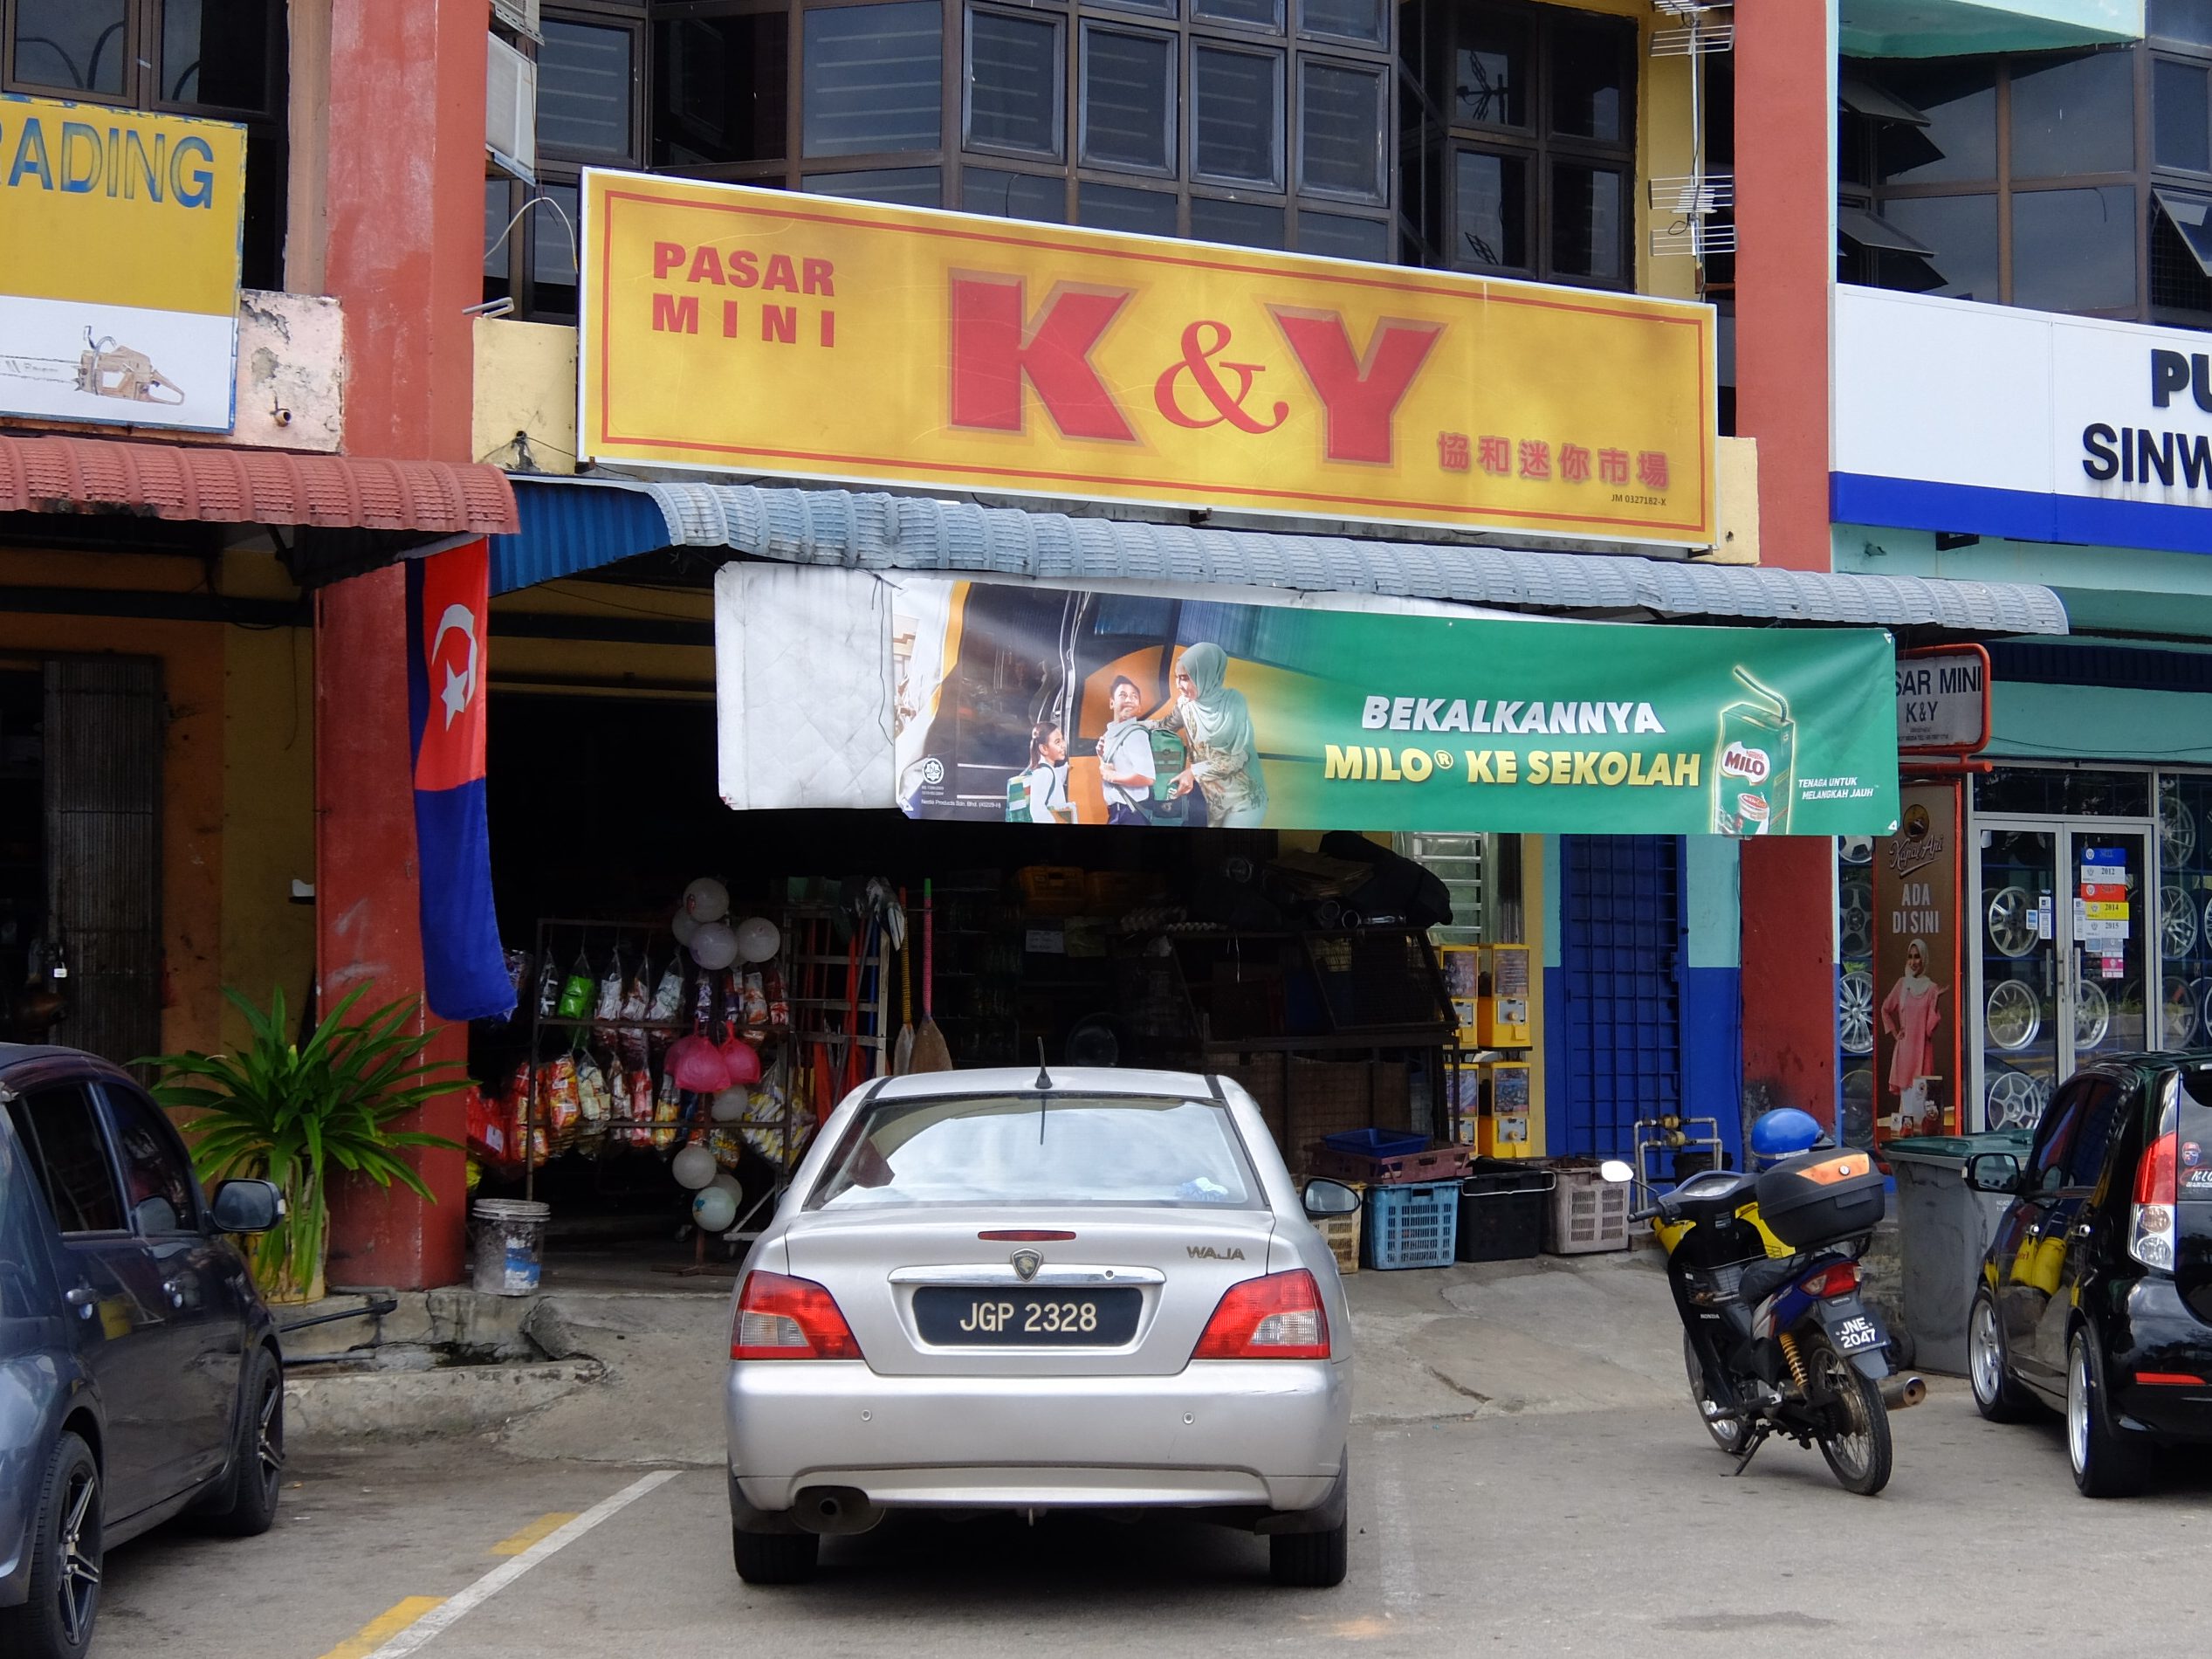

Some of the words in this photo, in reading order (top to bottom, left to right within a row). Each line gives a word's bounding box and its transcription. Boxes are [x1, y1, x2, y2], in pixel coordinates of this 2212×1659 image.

[0, 117, 214, 210] ADING
[653, 241, 835, 297] PASAR
[652, 293, 835, 348] MINI
[1437, 430, 1670, 491] 協和迷你市場
[1611, 493, 1624, 503] JM
[1940, 666, 1982, 694] MINI
[1362, 695, 1666, 733] BEKALKANNYA
[1906, 701, 1938, 723] K&Y
[1465, 750, 1518, 783] KE
[1526, 751, 1700, 786] SEKOLAH
[1724, 750, 1765, 776] MILO
[1798, 778, 1828, 788] TENAGA
[1829, 776, 1858, 787] UNTUK
[1802, 788, 1849, 800] MELANGKAH
[1850, 788, 1874, 798] JAUH
[1901, 883, 1931, 906] ADA
[1892, 911, 1907, 934] DI
[1910, 911, 1940, 934] SINI
[1186, 1246, 1246, 1261] WAJA
[959, 1302, 1015, 1332] JGP
[1024, 1302, 1097, 1332] 2328
[1840, 1317, 1870, 1336] JNE
[1840, 1327, 1876, 1349] 2047
